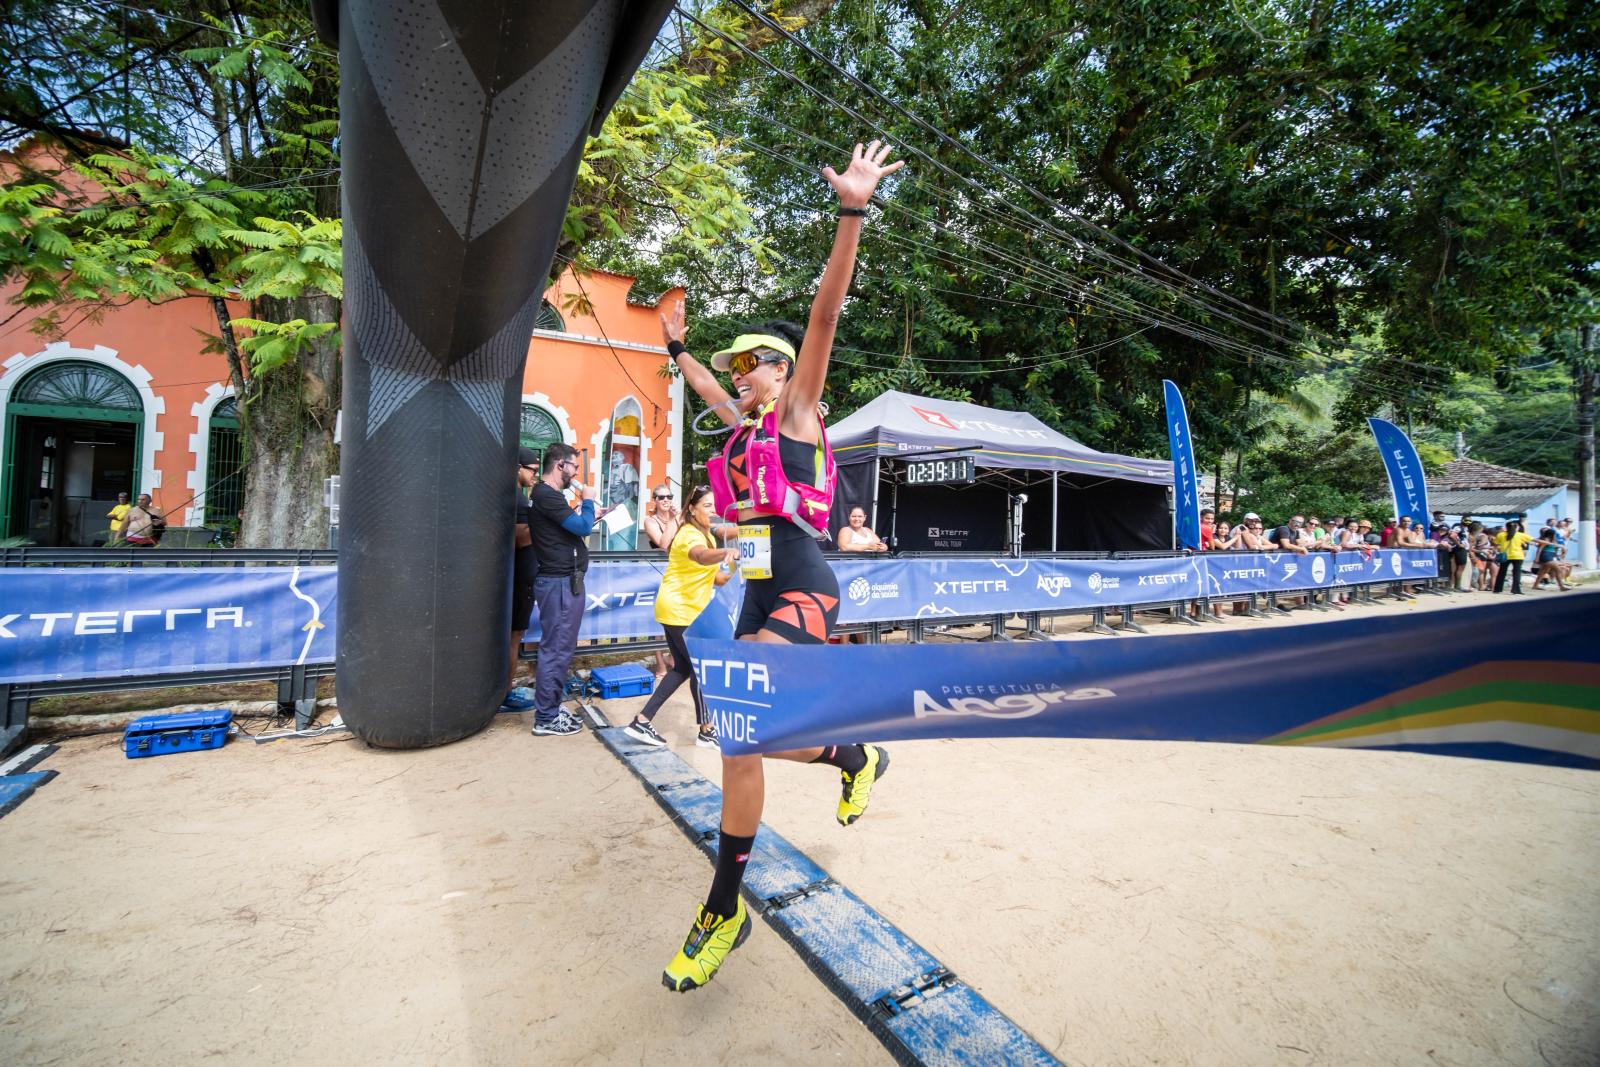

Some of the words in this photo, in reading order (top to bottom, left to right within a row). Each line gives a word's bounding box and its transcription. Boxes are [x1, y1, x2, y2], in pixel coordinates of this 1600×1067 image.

[952, 418, 1047, 439] XTERRA
[908, 461, 967, 483] 02:39:11
[1393, 449, 1420, 512] XTERRA
[940, 529, 969, 537] XTERRA
[1138, 573, 1188, 586] XTERRA
[1223, 568, 1266, 580] XTERRA
[933, 580, 1009, 595] XTERRA
[585, 591, 657, 611] XTE
[941, 683, 1061, 696] PREFEITURA
[913, 687, 1118, 720] Angra
